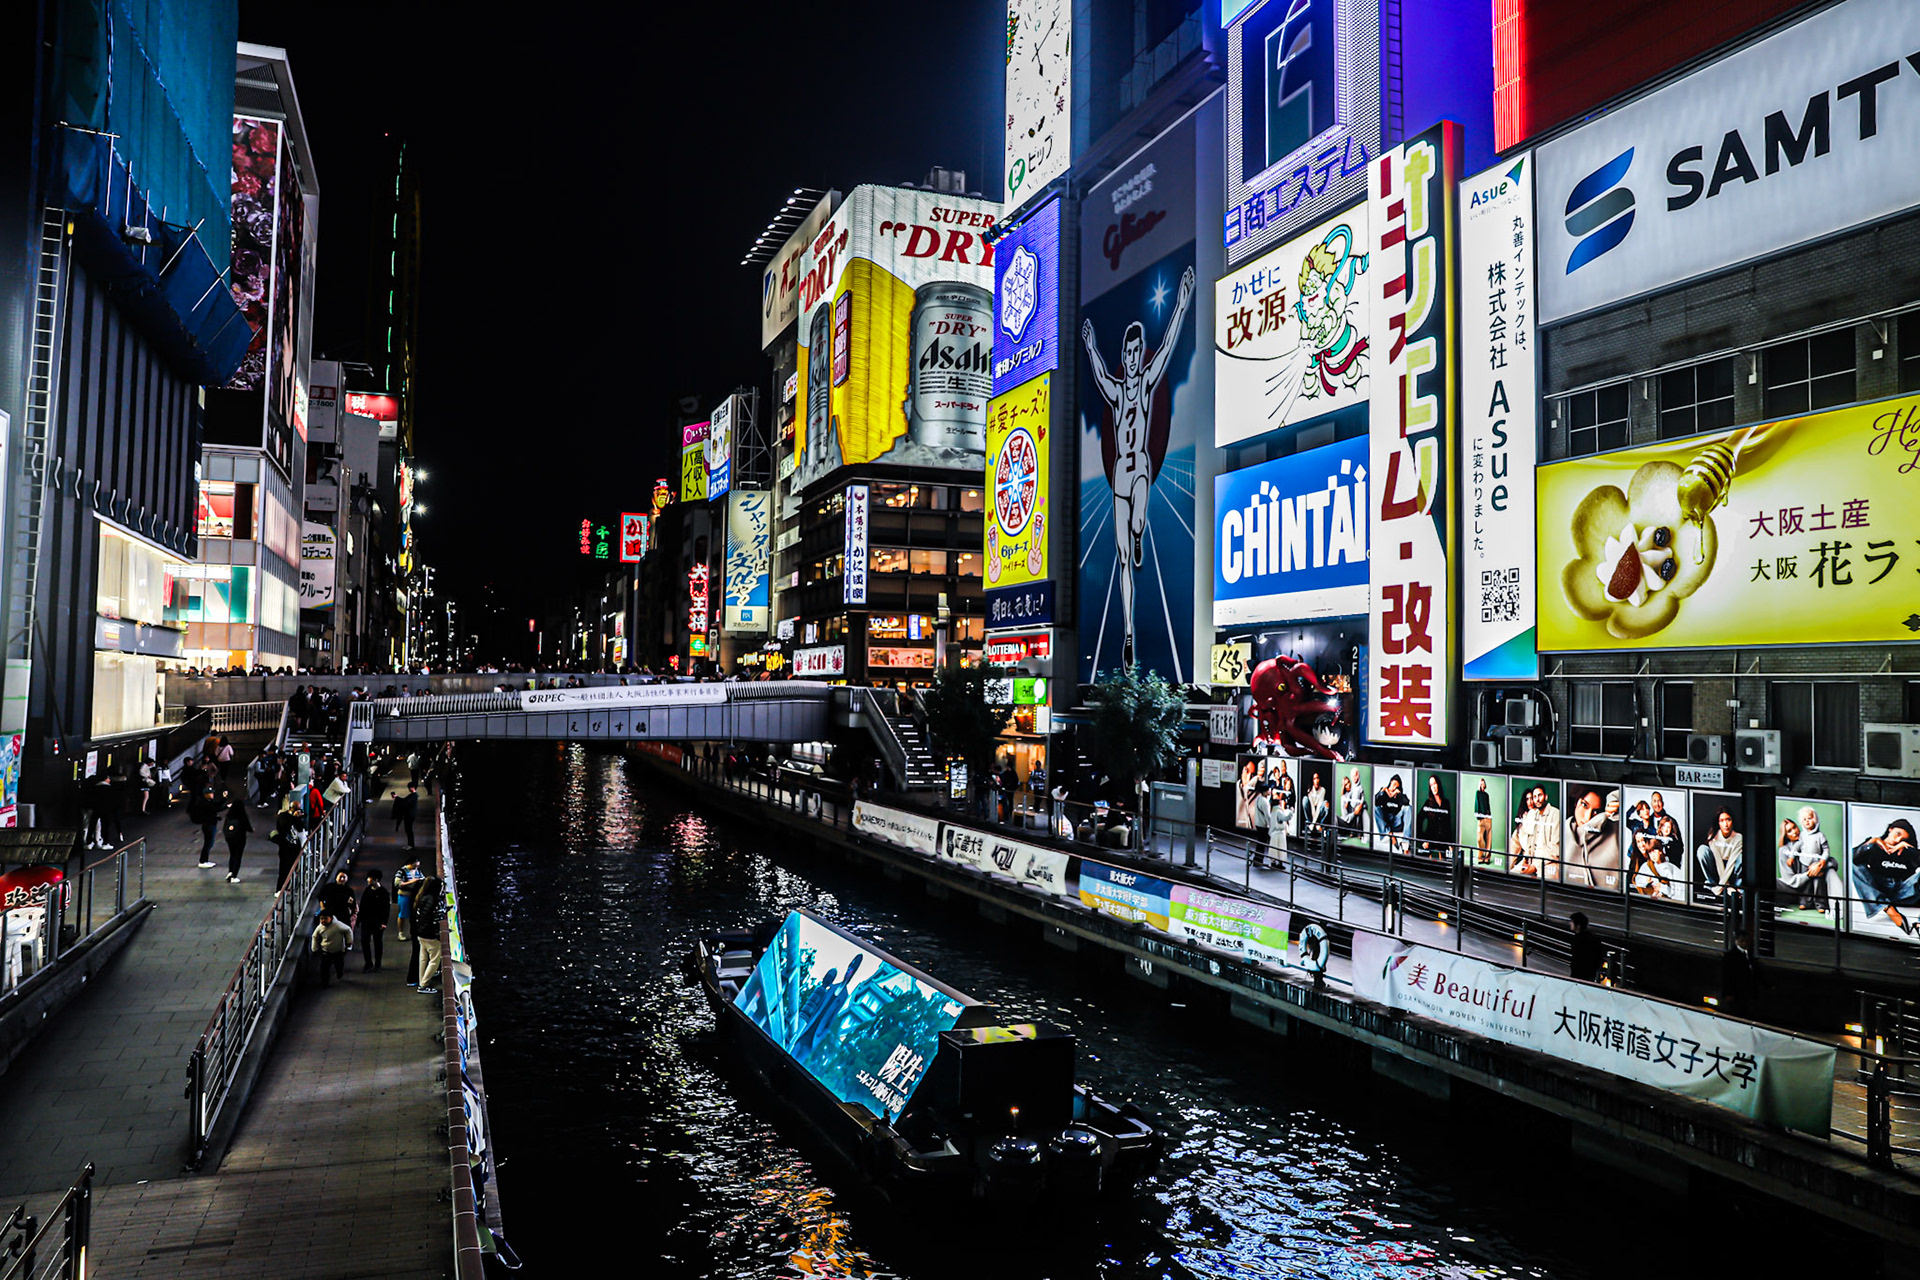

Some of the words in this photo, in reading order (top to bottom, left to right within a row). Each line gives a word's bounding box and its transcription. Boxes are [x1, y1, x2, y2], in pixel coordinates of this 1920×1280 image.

[1666, 52, 1920, 212] SAMT
[929, 206, 995, 228] SUPER
[1222, 136, 1371, 248] 日商エステム
[1470, 181, 1508, 209] Asue
[1231, 266, 1281, 304] かぜに
[945, 313, 972, 322] SUPER
[1226, 286, 1287, 349] 改源
[1488, 261, 1508, 371] 株式会社
[934, 401, 980, 411] スーパードライ
[1125, 401, 1138, 473] グリコ
[1488, 380, 1510, 512] Asue
[1473, 437, 1485, 559] に変わりました。
[1749, 498, 1871, 539] 大阪土産
[1750, 556, 1798, 583] 大阪
[1809, 540, 1920, 588] 花ラ
[988, 643, 1020, 656] LOTTERIA
[1678, 771, 1701, 783] BAR
[1406, 962, 1430, 992] 美
[1433, 972, 1536, 1020] Beautiful
[1553, 1005, 1758, 1089] 大阪樟蔭女子大学
